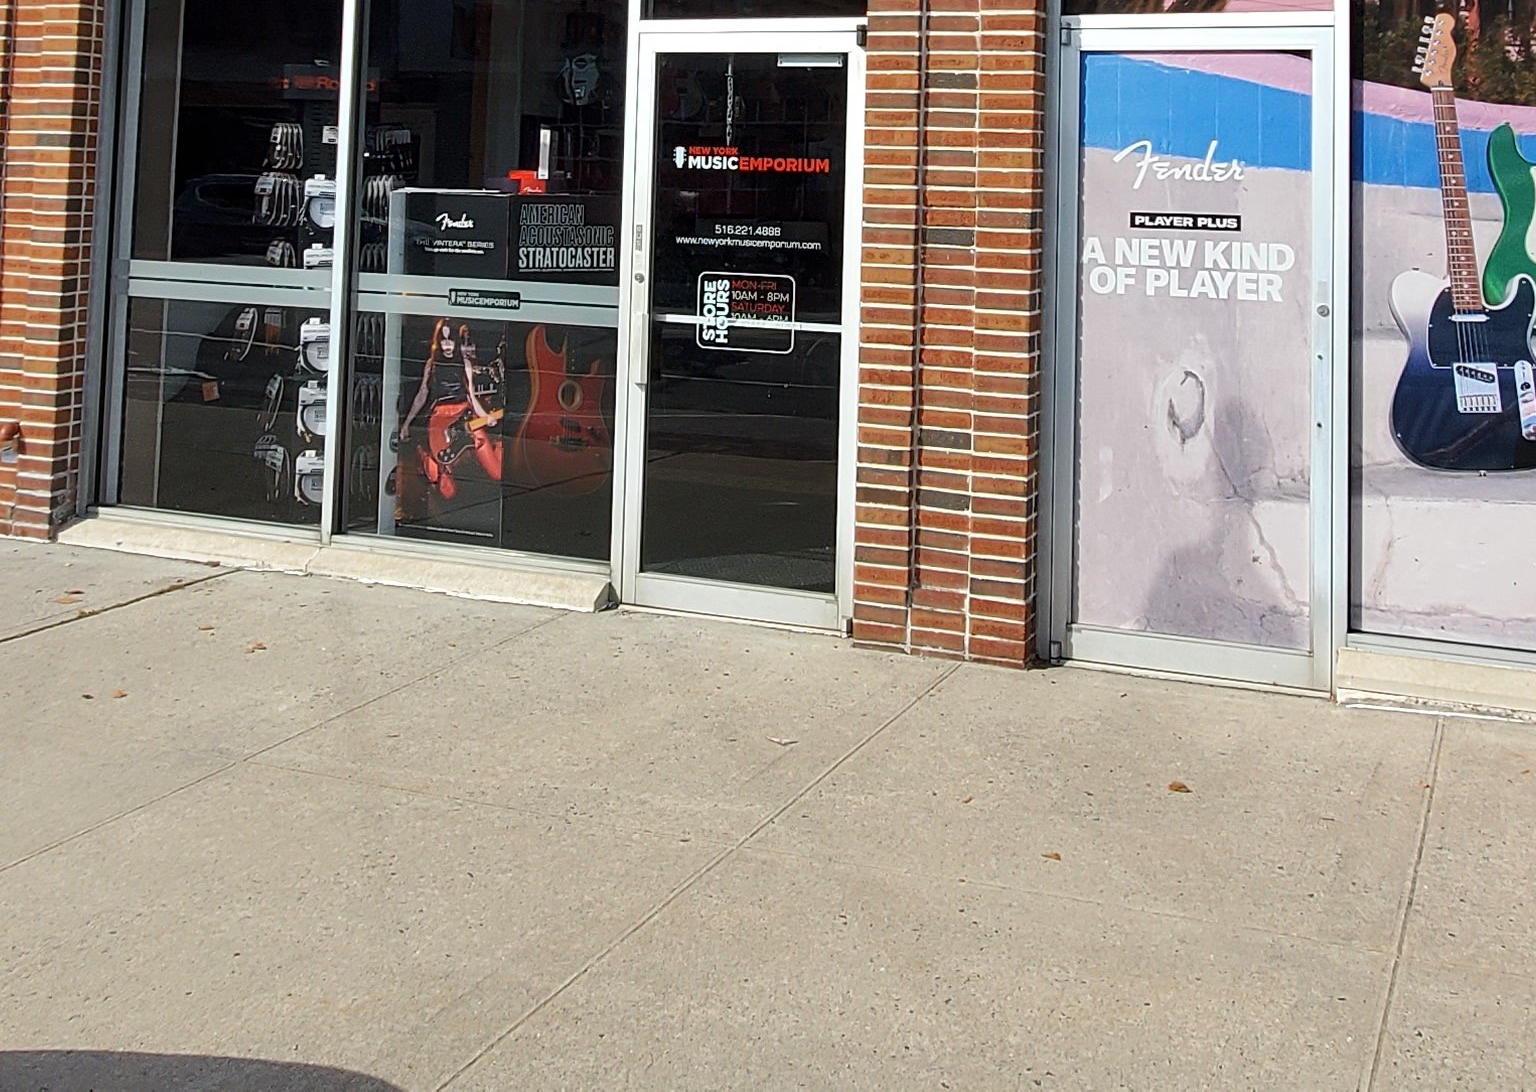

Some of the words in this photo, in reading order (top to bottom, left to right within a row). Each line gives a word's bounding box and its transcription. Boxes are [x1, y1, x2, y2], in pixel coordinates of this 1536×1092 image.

[688, 146, 711, 155] NEW
[712, 146, 739, 156] YORK
[1113, 140, 1246, 190] Fender
[435, 212, 475, 231] Fender
[520, 203, 585, 226] AMERICAN
[1134, 215, 1194, 228] PLAYER
[1197, 217, 1239, 229] PLUS
[519, 225, 615, 248] ACOUSTASONIC
[675, 236, 822, 250] www.newyorkmusicemporium.com
[518, 247, 615, 269] STRATOCASTER
[1082, 236, 1106, 265] A
[1114, 237, 1197, 268] NEW
[1204, 240, 1296, 272] KIND
[1089, 266, 1137, 295] OF
[1145, 268, 1284, 302] PLAYER
[731, 290, 758, 301] 10AM
[766, 292, 790, 303] 8PM
[731, 302, 785, 313] SATURDAY
[715, 279, 731, 344] HOURS
